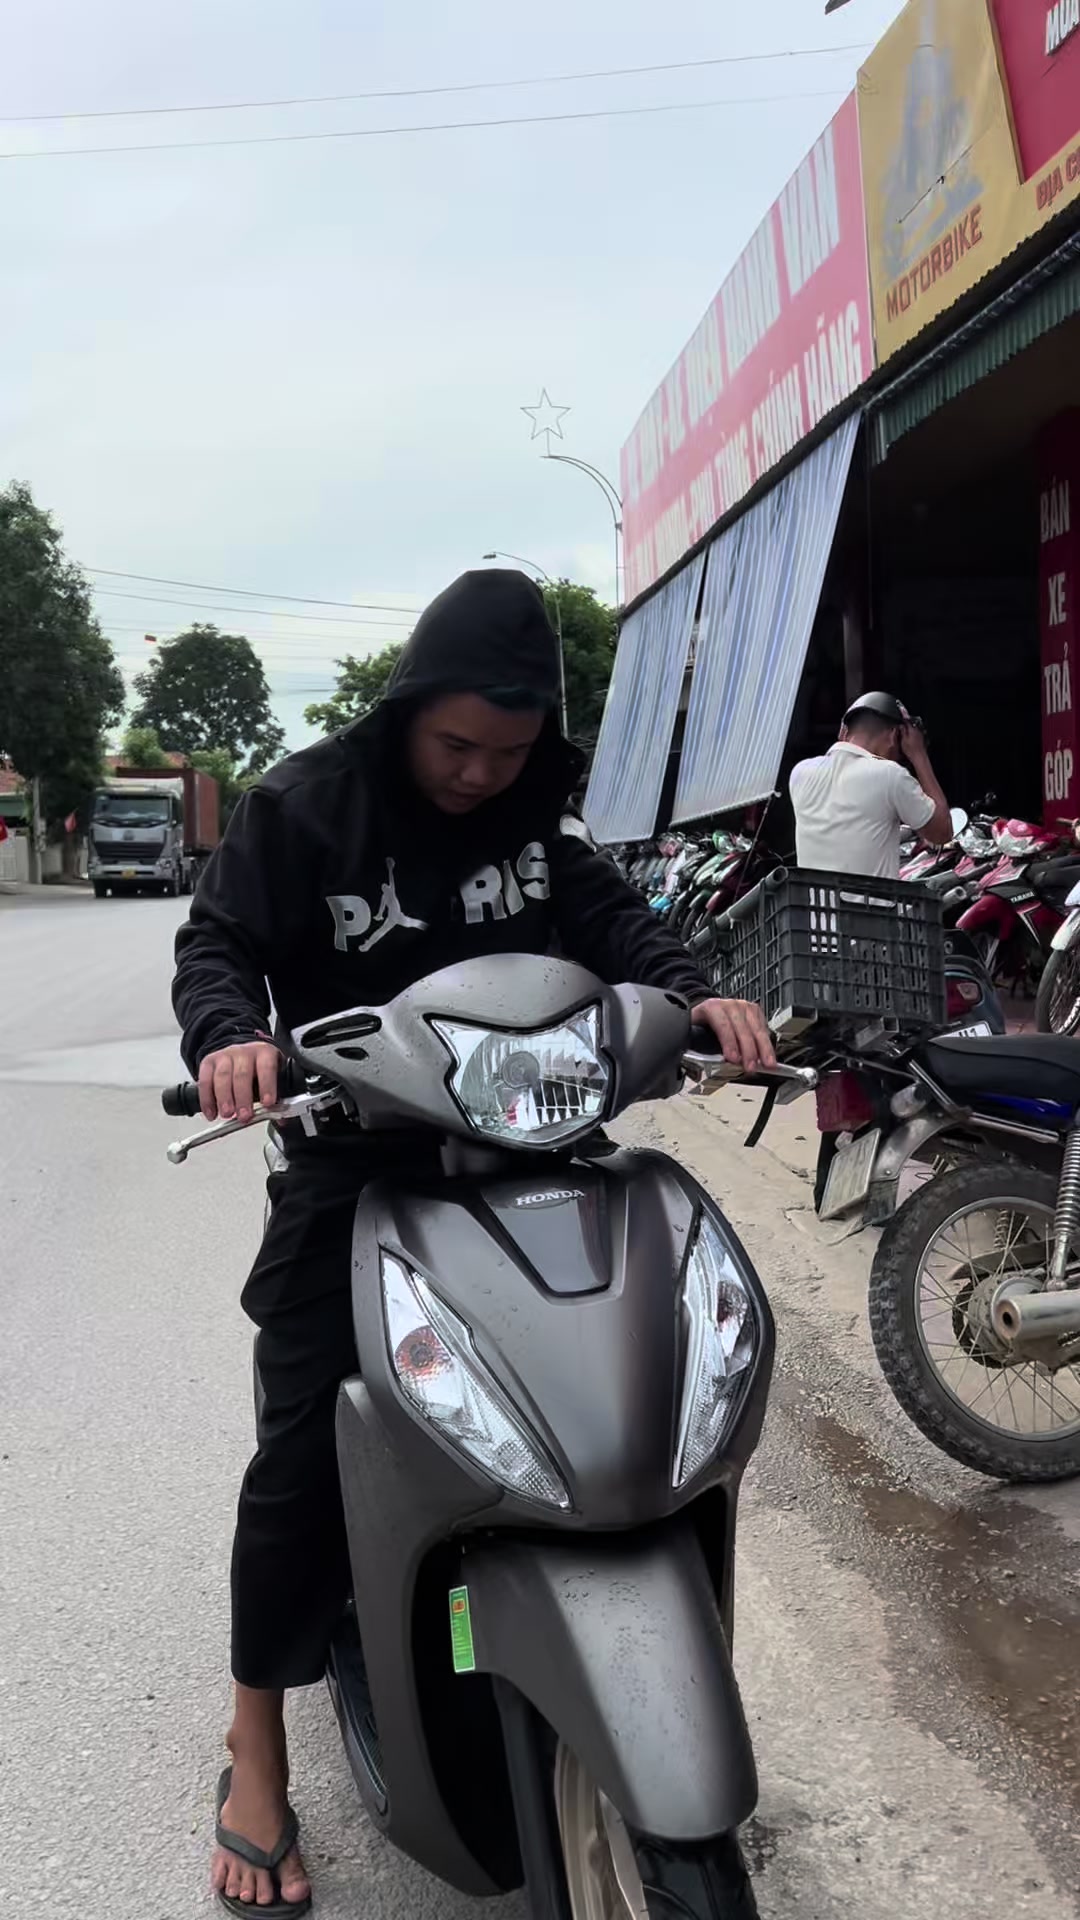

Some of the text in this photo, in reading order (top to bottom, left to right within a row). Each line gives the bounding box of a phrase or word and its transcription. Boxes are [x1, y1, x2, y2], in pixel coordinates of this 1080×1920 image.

[885, 203, 984, 323] MOTORBIKE
[1040, 475, 1071, 543] BÁN
[1048, 571, 1067, 626] XE
[1044, 641, 1072, 715] TRẢ
[1044, 740, 1073, 801] GÓP
[515, 1189, 585, 1206] HONDA
